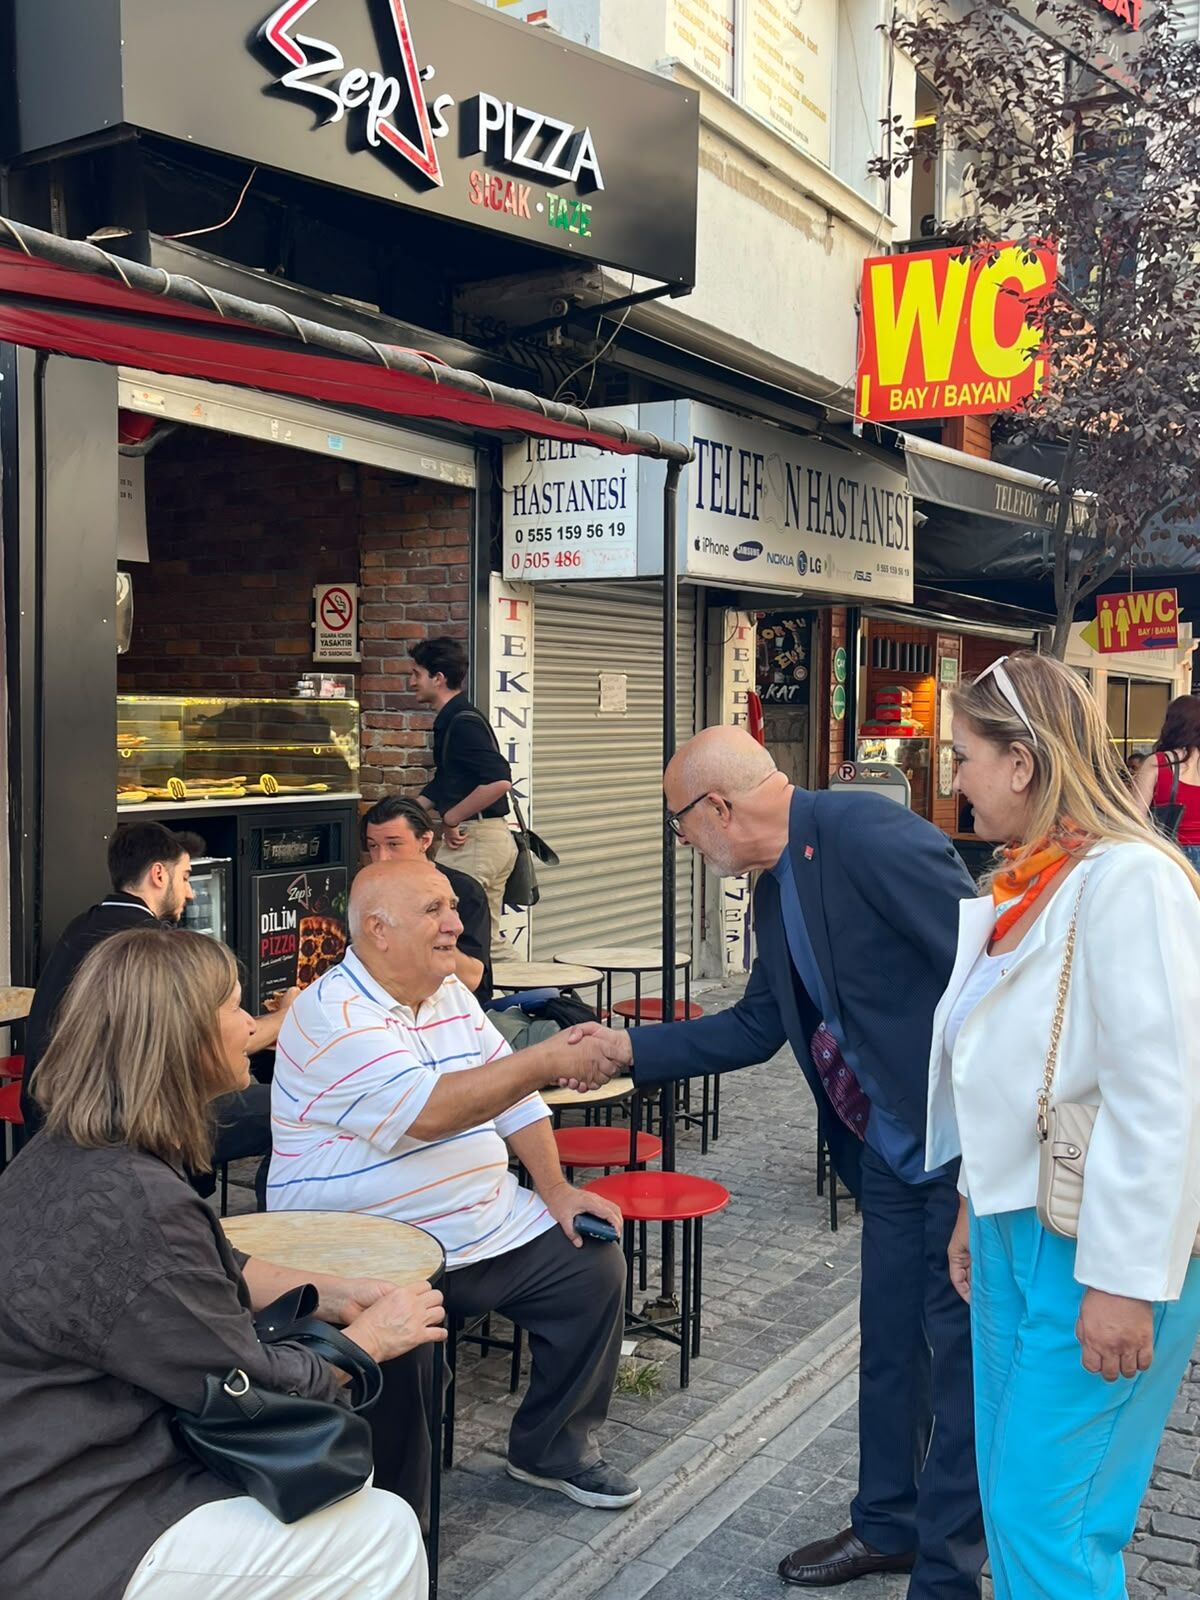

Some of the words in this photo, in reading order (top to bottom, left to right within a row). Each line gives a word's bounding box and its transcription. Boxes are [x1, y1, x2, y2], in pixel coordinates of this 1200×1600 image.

[281, 33, 455, 147] Zep's
[479, 91, 605, 190] PIZZA
[469, 169, 531, 219] SICAK
[546, 191, 592, 237] TAZE
[870, 246, 1047, 387] WC
[889, 387, 929, 411] BAY
[944, 380, 1011, 407] BAYAN
[513, 468, 627, 516] HASTANESİ
[515, 530, 523, 543] 0
[528, 528, 552, 543] 555
[557, 525, 581, 540] 159
[587, 524, 603, 539] 56
[608, 522, 625, 537] 19
[703, 537, 729, 557] iPhone
[511, 553, 520, 569] 0
[524, 552, 550, 569] 505
[554, 550, 581, 568] 486
[767, 552, 794, 567] NOKIA
[810, 557, 822, 574] LG
[1127, 591, 1175, 624] WC
[1138, 628, 1150, 636] BAY
[1154, 626, 1176, 636] BAYAN
[170, 781, 184, 797] 80
[263, 777, 276, 793] 80
[261, 906, 296, 934] DİLİM
